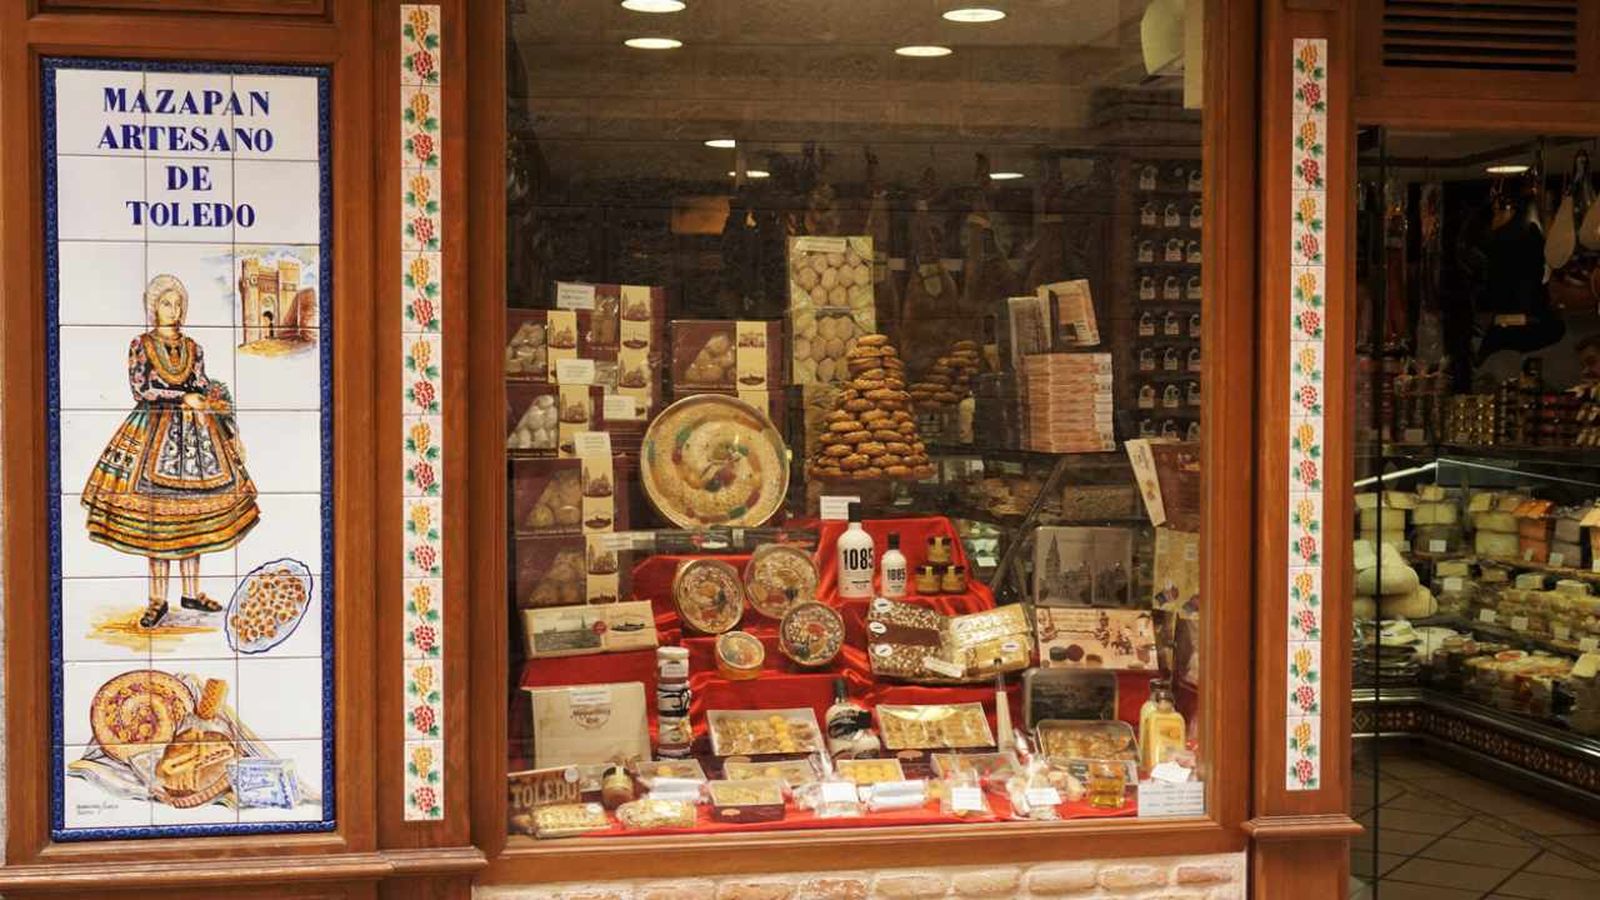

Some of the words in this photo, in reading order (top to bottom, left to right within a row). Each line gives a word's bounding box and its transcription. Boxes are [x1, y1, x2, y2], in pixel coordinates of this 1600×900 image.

[103, 87, 270, 116] MAZAPAN
[98, 124, 273, 153] ARTESANO
[166, 165, 212, 191] DE
[126, 201, 256, 228] TOLEDO
[843, 548, 873, 570] 1085
[510, 780, 578, 808] TOLEDO
